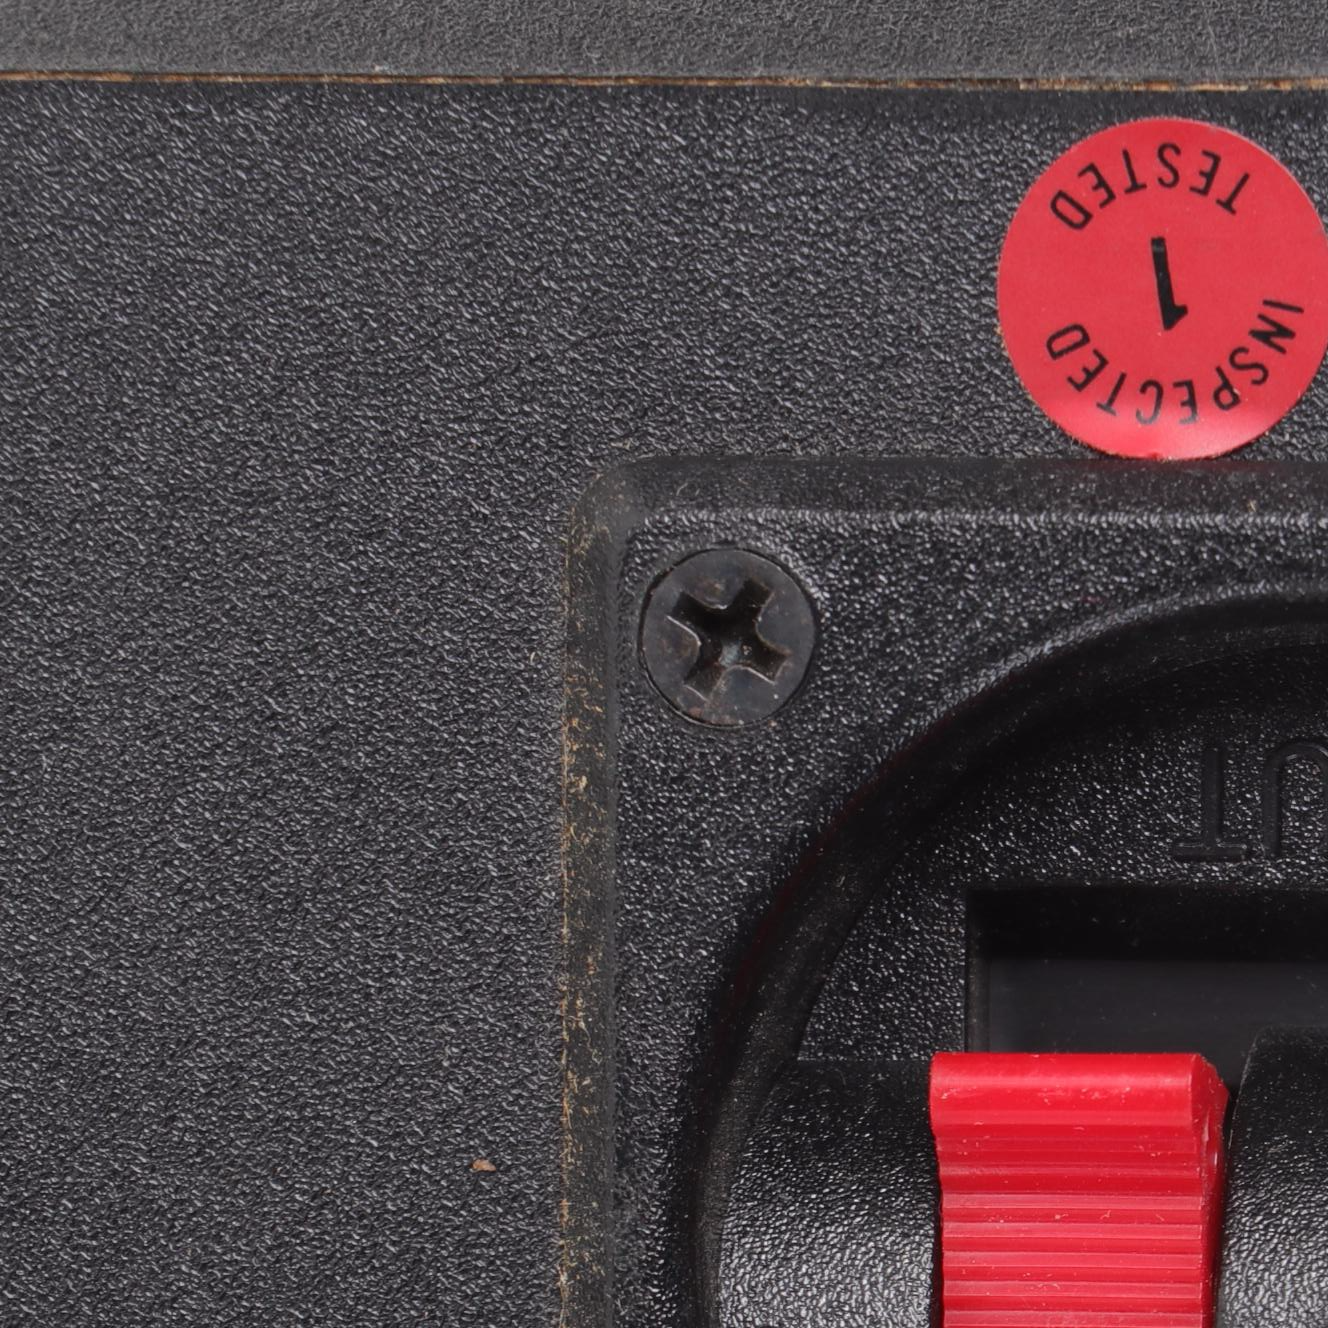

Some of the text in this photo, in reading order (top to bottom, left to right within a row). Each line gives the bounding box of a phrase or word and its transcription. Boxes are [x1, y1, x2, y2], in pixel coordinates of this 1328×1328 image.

[1049, 142, 1251, 230] TESTED
[1150, 236, 1188, 331] 1
[1046, 298, 1304, 425] INSPECTED
